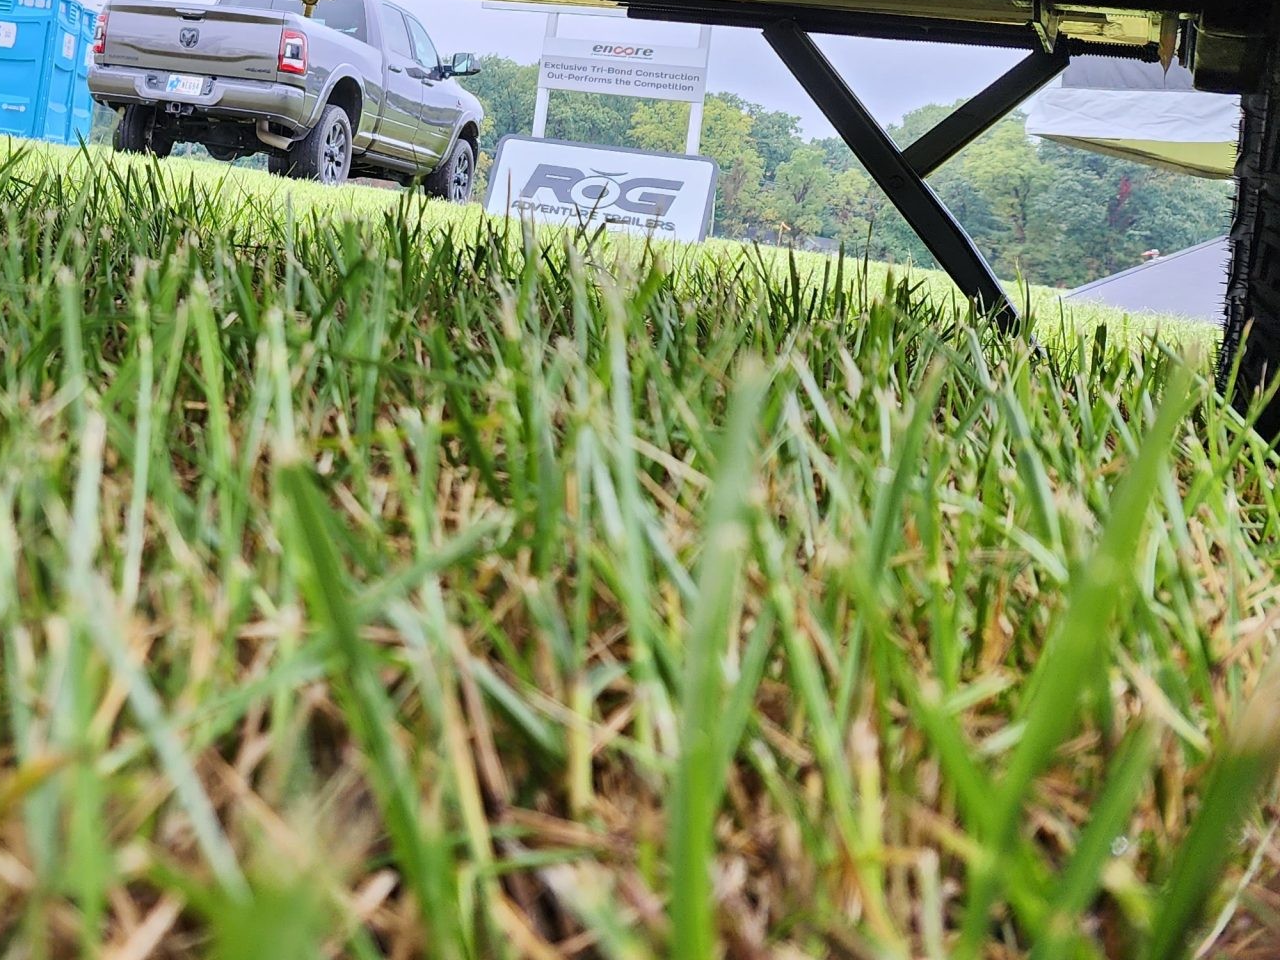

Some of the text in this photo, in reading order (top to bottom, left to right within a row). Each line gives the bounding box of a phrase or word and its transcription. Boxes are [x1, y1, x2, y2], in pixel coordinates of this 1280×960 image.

[592, 43, 654, 56] encore
[544, 61, 700, 82] Exclusive Tri-Bond Construction
[547, 71, 694, 92] Out-Performs the Competition
[521, 163, 685, 217] ROG
